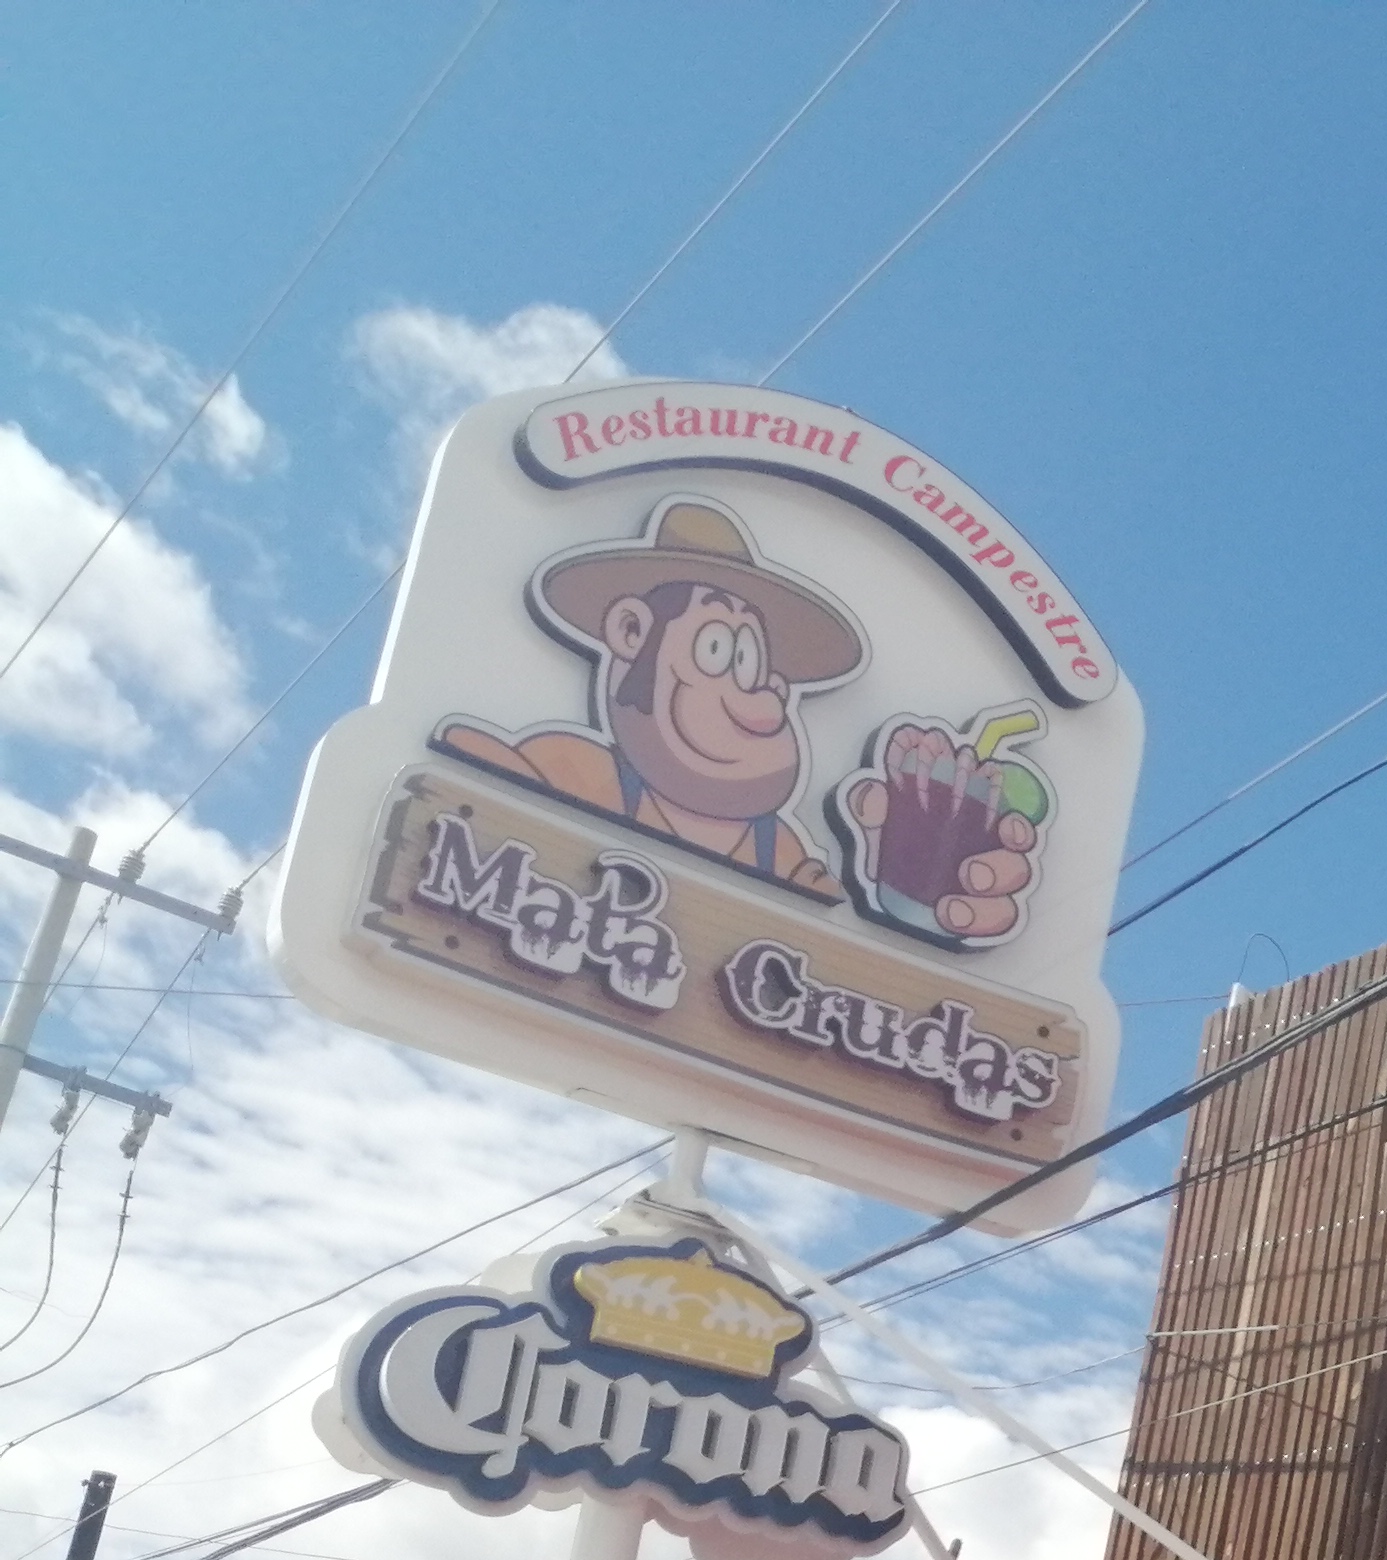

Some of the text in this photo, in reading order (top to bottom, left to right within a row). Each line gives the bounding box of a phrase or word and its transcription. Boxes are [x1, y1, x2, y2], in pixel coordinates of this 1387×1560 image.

[553, 397, 1101, 681] Restaurant Campestre
[418, 812, 1063, 1121] Mata Crudas
[379, 1305, 906, 1524] Corona
